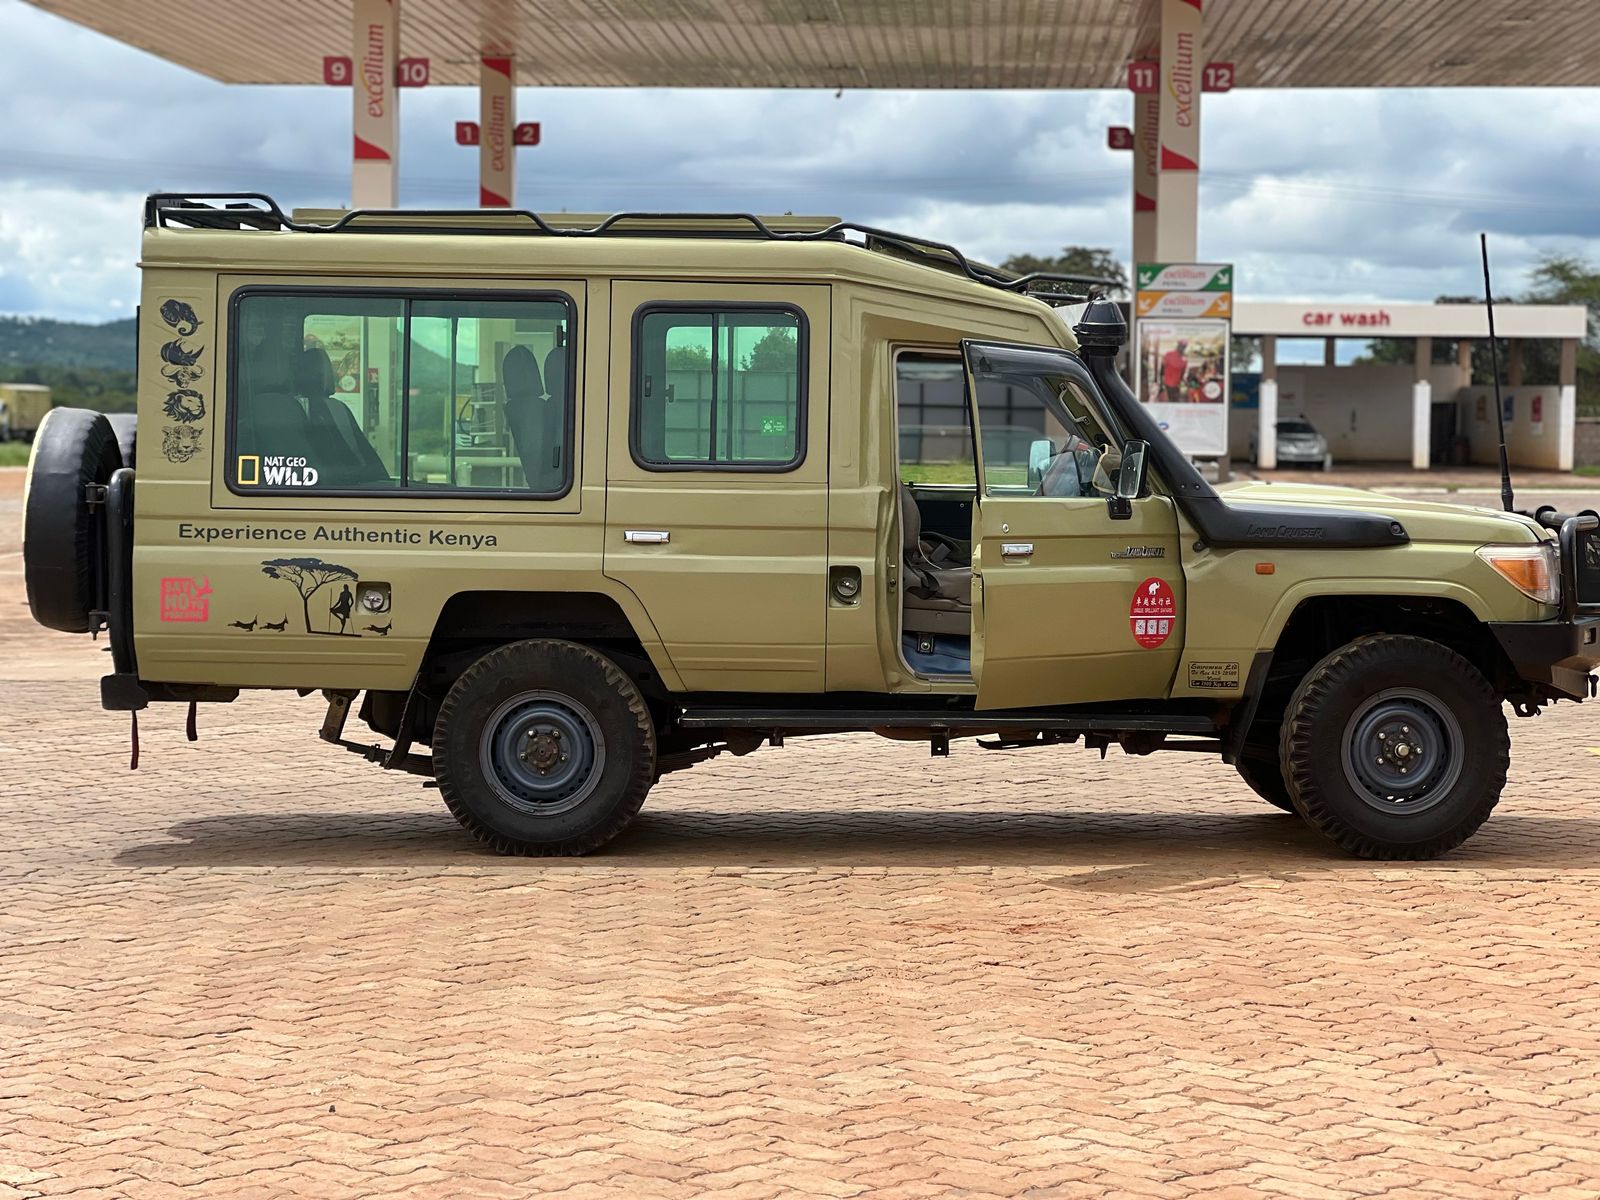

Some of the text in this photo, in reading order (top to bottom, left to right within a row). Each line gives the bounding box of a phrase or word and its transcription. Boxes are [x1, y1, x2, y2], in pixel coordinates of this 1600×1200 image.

[331, 62, 346, 81] 9
[363, 24, 384, 118] excellium
[400, 63, 427, 82] 10
[1133, 69, 1153, 88] 11
[1172, 32, 1194, 128] excellium
[1206, 68, 1231, 88] 12
[489, 95, 506, 172] excellium
[521, 126, 534, 142] 2
[1113, 131, 1126, 146] 3
[1302, 310, 1391, 327] car wash
[263, 456, 307, 467] NAT GEO
[263, 467, 318, 487] WILD
[178, 523, 498, 550] Experience Authentic Kenya
[165, 593, 204, 609] NO TO
